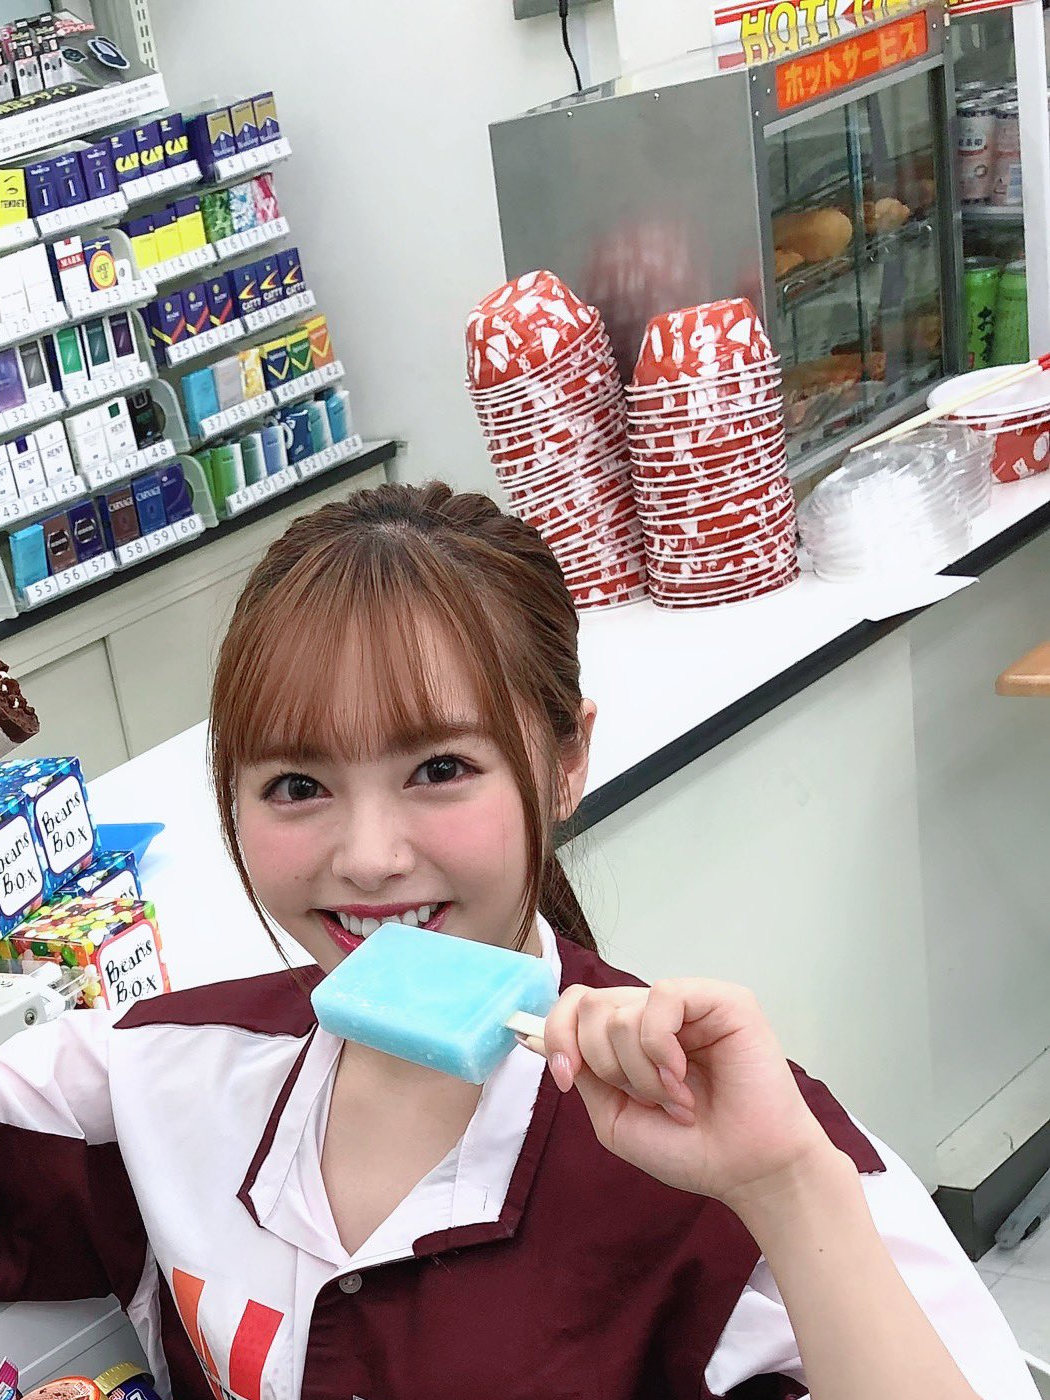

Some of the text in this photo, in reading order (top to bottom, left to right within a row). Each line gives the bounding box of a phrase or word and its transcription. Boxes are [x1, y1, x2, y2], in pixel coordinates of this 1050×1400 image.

[784, 21, 918, 103] ホットサービス
[269, 220, 283, 232] 18
[245, 230, 259, 241] 17
[223, 237, 237, 248] 16
[195, 251, 208, 261] 15
[146, 266, 160, 278] 13
[171, 260, 185, 271] 14
[133, 282, 148, 294] 24
[106, 290, 121, 303] 23
[297, 293, 311, 306] 30
[78, 298, 93, 311] 22
[272, 303, 287, 317] 29
[41, 310, 55, 322] 21
[251, 312, 265, 326] 28
[13, 318, 30, 333] 20
[222, 323, 237, 336] 27
[199, 334, 214, 347] 26
[175, 345, 190, 358] 25
[129, 366, 144, 380] 36
[326, 365, 340, 376] 42
[101, 375, 117, 389] 35
[303, 375, 317, 387] 41
[74, 385, 90, 399] 34
[281, 384, 296, 397] 40
[41, 397, 57, 412] 33
[254, 396, 269, 409] 39
[13, 408, 29, 422] 32
[232, 406, 246, 419] 38
[208, 417, 223, 430] 37
[344, 437, 358, 449] 54
[151, 443, 168, 458] 48
[324, 448, 339, 460] 53
[123, 454, 140, 469] 47
[304, 457, 318, 470] 52
[95, 465, 113, 480] 46
[279, 469, 293, 483] 51
[60, 481, 78, 495] 45
[256, 481, 271, 494] 50
[31, 492, 49, 507] 44
[236, 491, 249, 504] 49
[2, 503, 21, 518] 43
[180, 518, 197, 534] 60
[153, 530, 170, 545] 59
[126, 542, 143, 558] 58
[91, 557, 108, 572] 57
[62, 567, 81, 584] 56
[34, 580, 52, 597] 55
[42, 790, 82, 838] Beans
[105, 938, 154, 987] Beans
